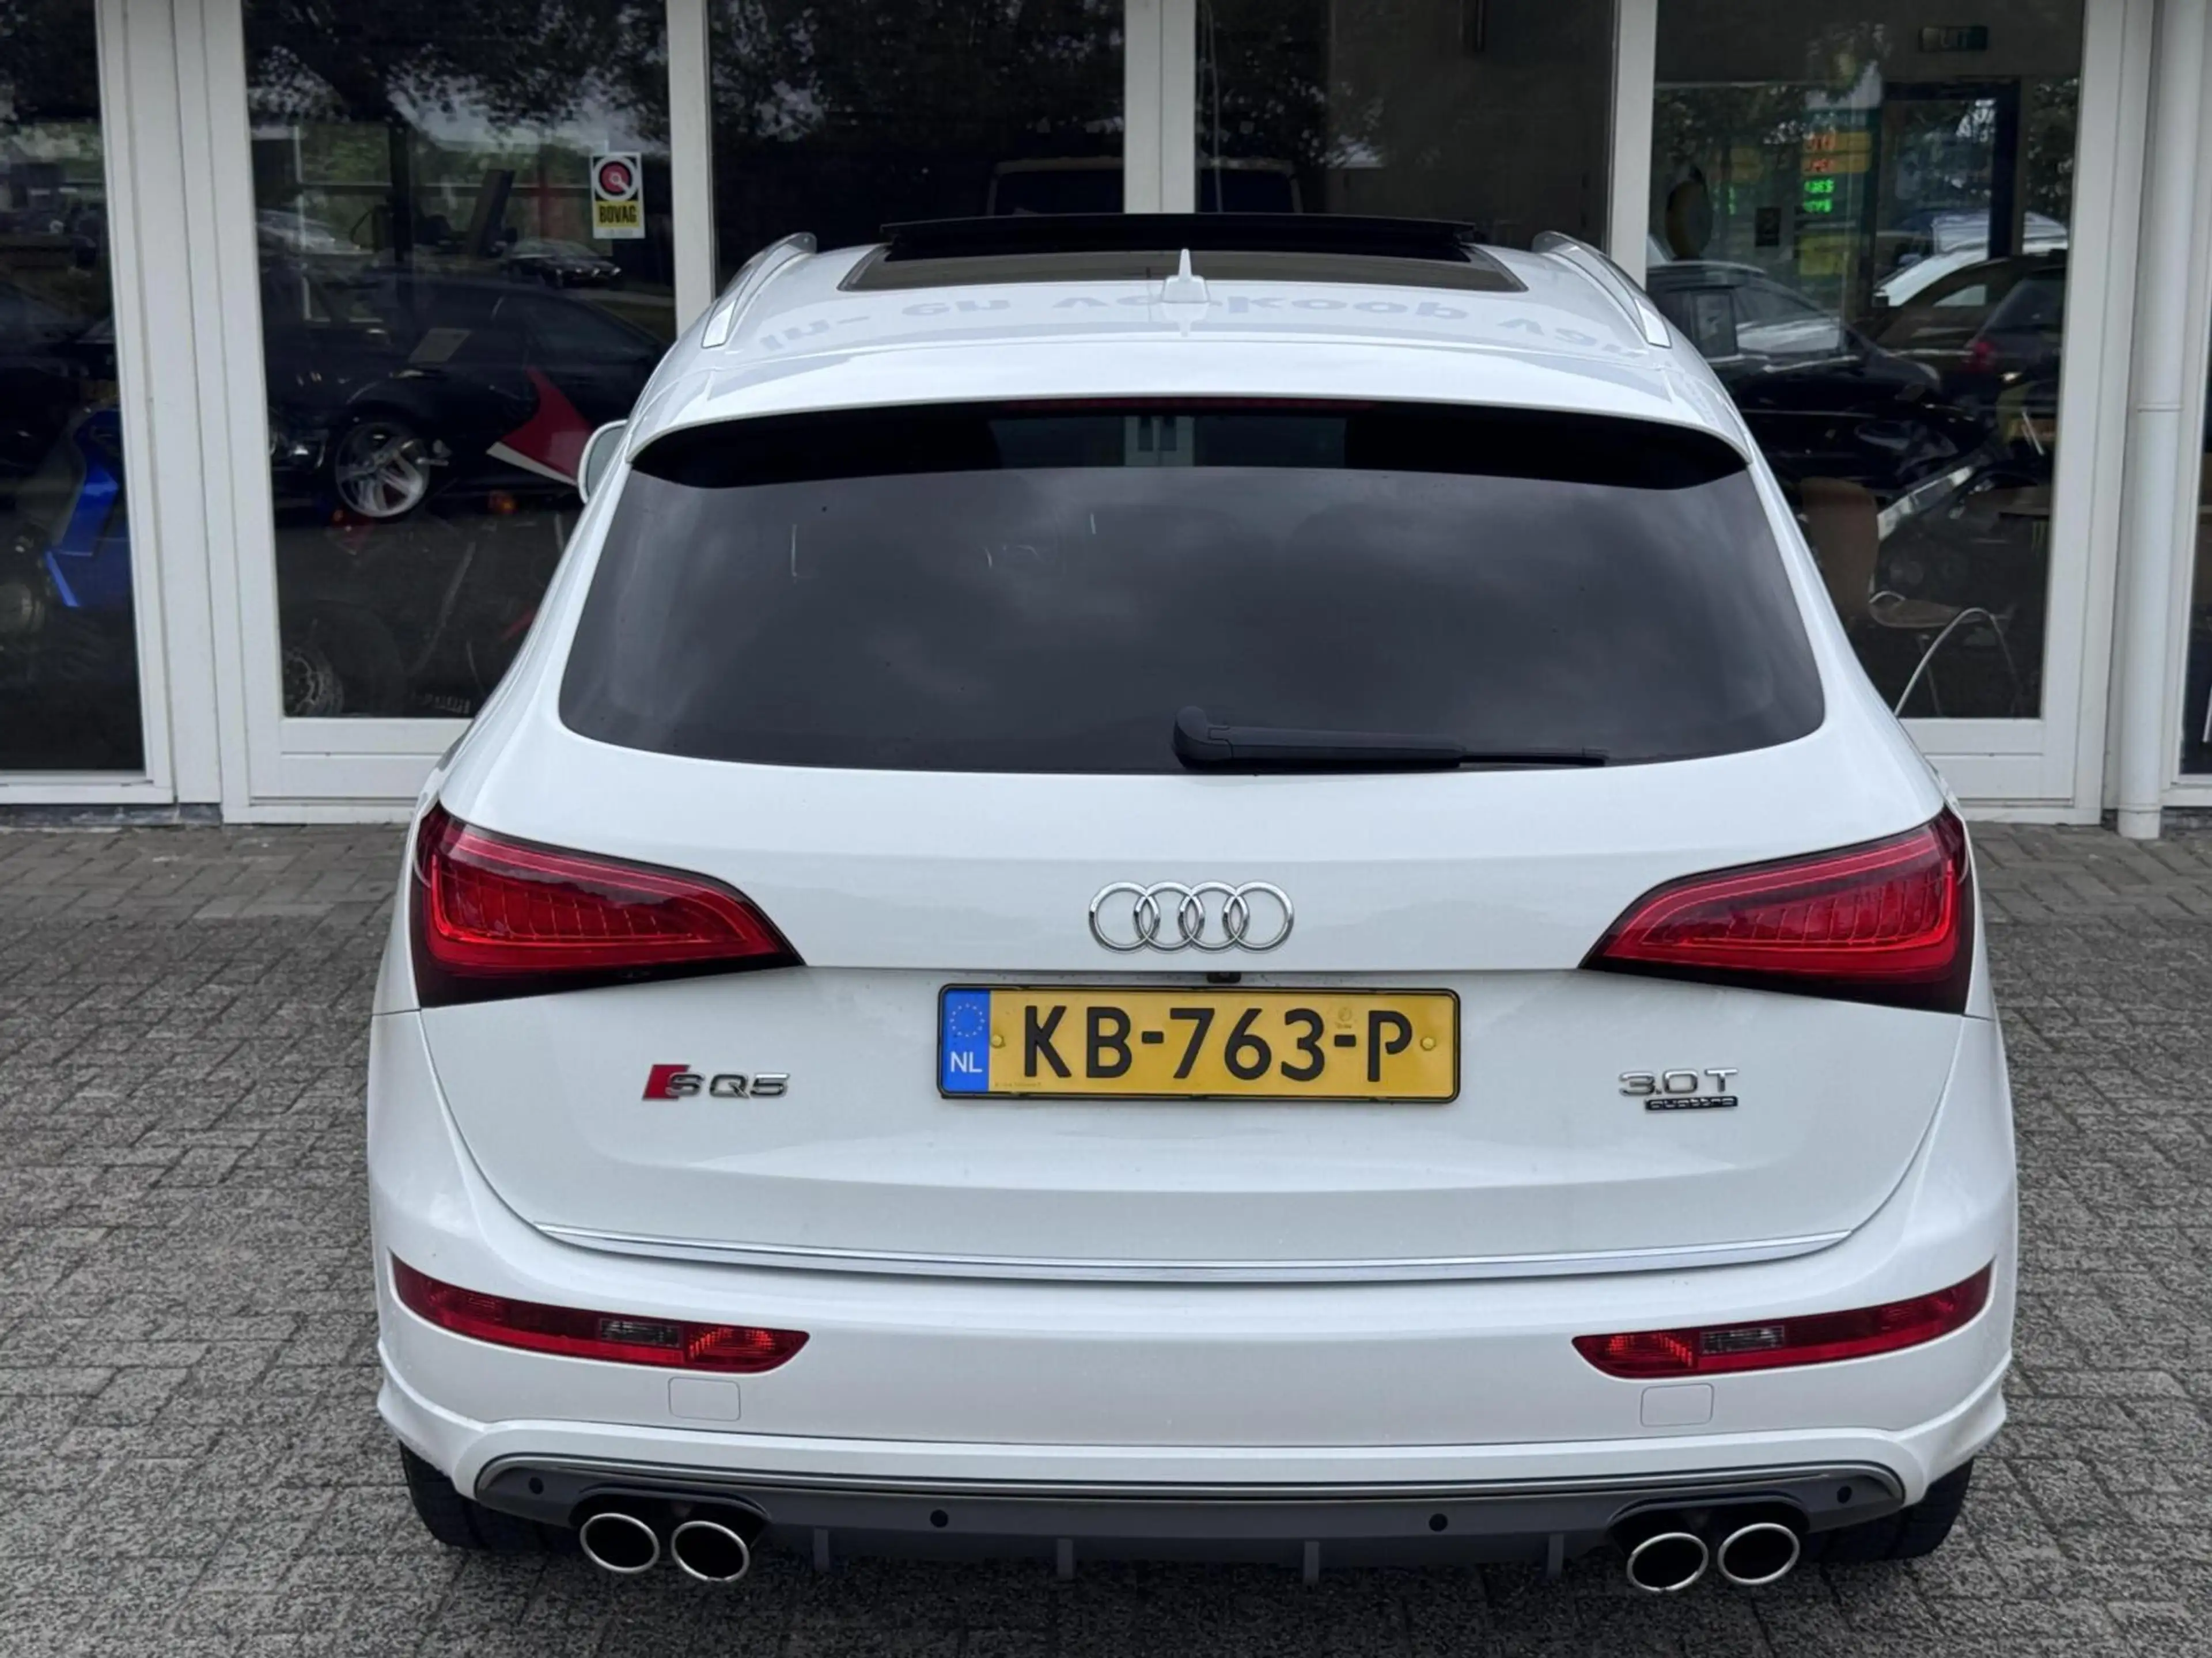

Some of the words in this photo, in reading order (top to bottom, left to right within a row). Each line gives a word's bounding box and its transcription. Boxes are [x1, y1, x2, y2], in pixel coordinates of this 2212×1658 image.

[600, 206, 637, 223] BOVAG
[1024, 1005, 1413, 1083] KB-763-P
[950, 1052, 982, 1074] NL
[664, 1071, 790, 1099] SQ5
